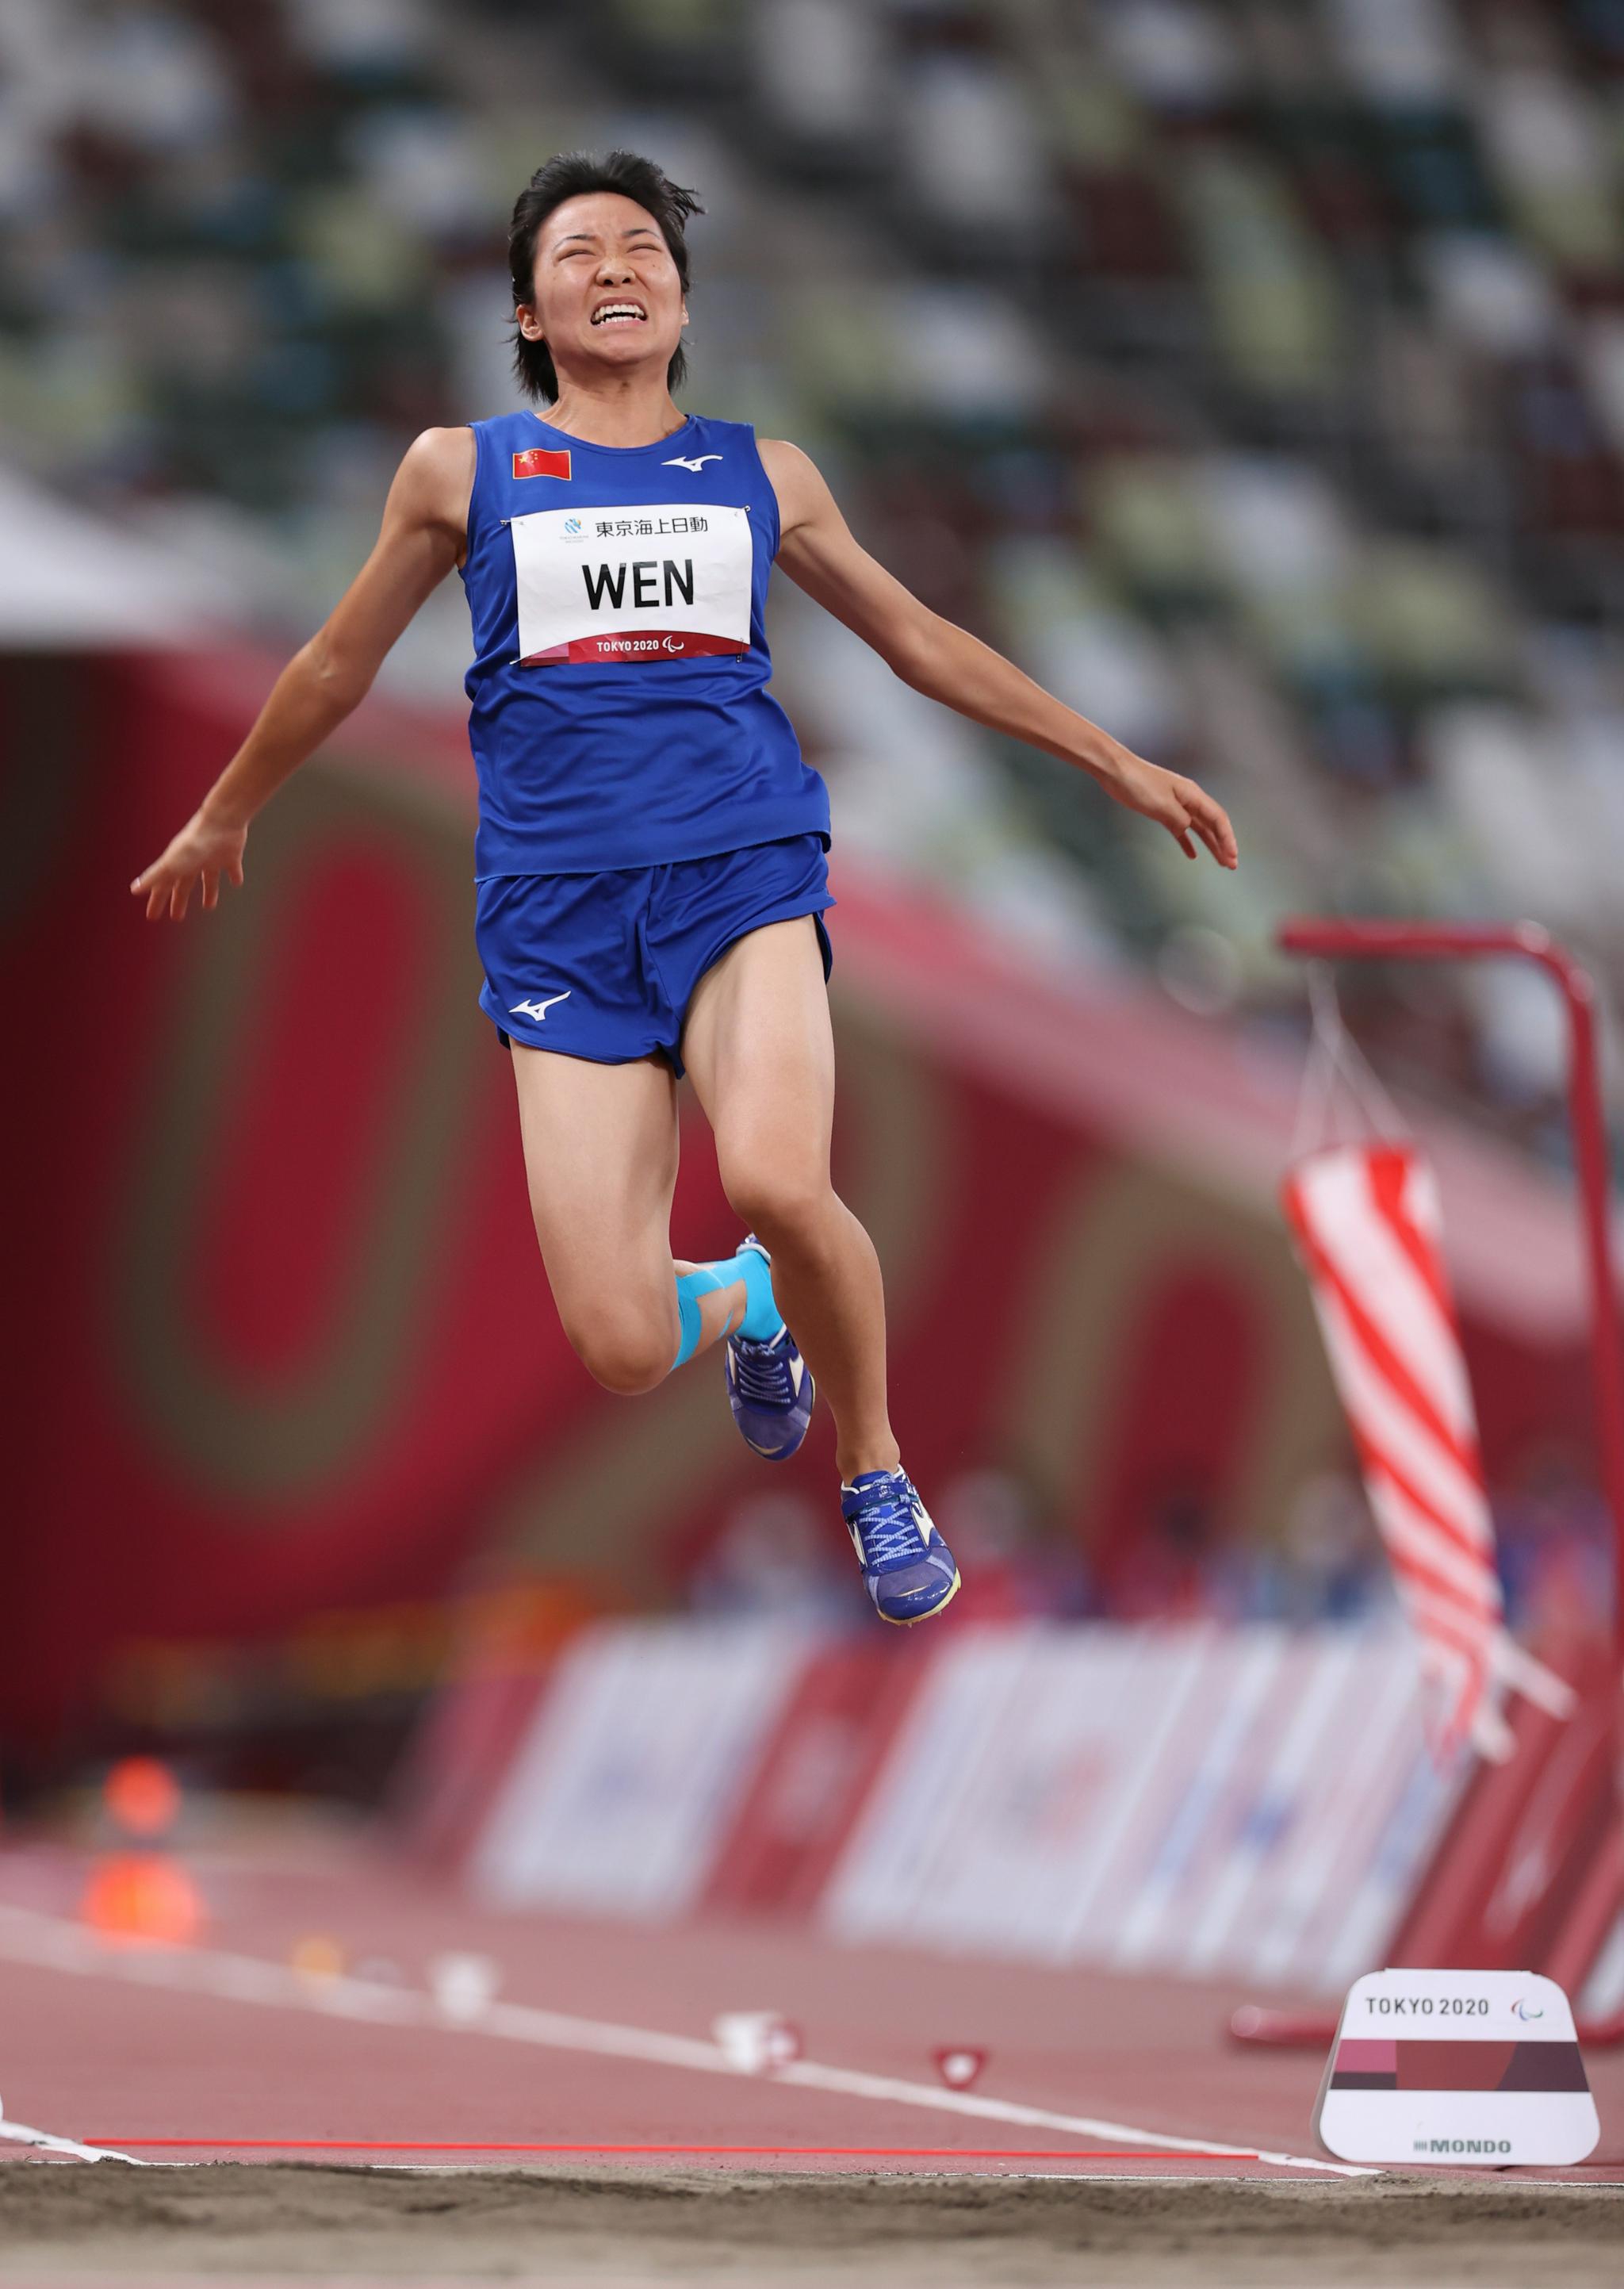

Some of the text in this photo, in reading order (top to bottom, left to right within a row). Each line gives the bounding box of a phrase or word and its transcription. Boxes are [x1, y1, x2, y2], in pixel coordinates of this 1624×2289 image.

[596, 516, 708, 538] 東京海上日動
[581, 559, 694, 610] WEN
[596, 640, 659, 652] TOKYO 2020
[1365, 1997, 1489, 2015] TOKYO 2020
[1430, 2139, 1511, 2153] MONDO
